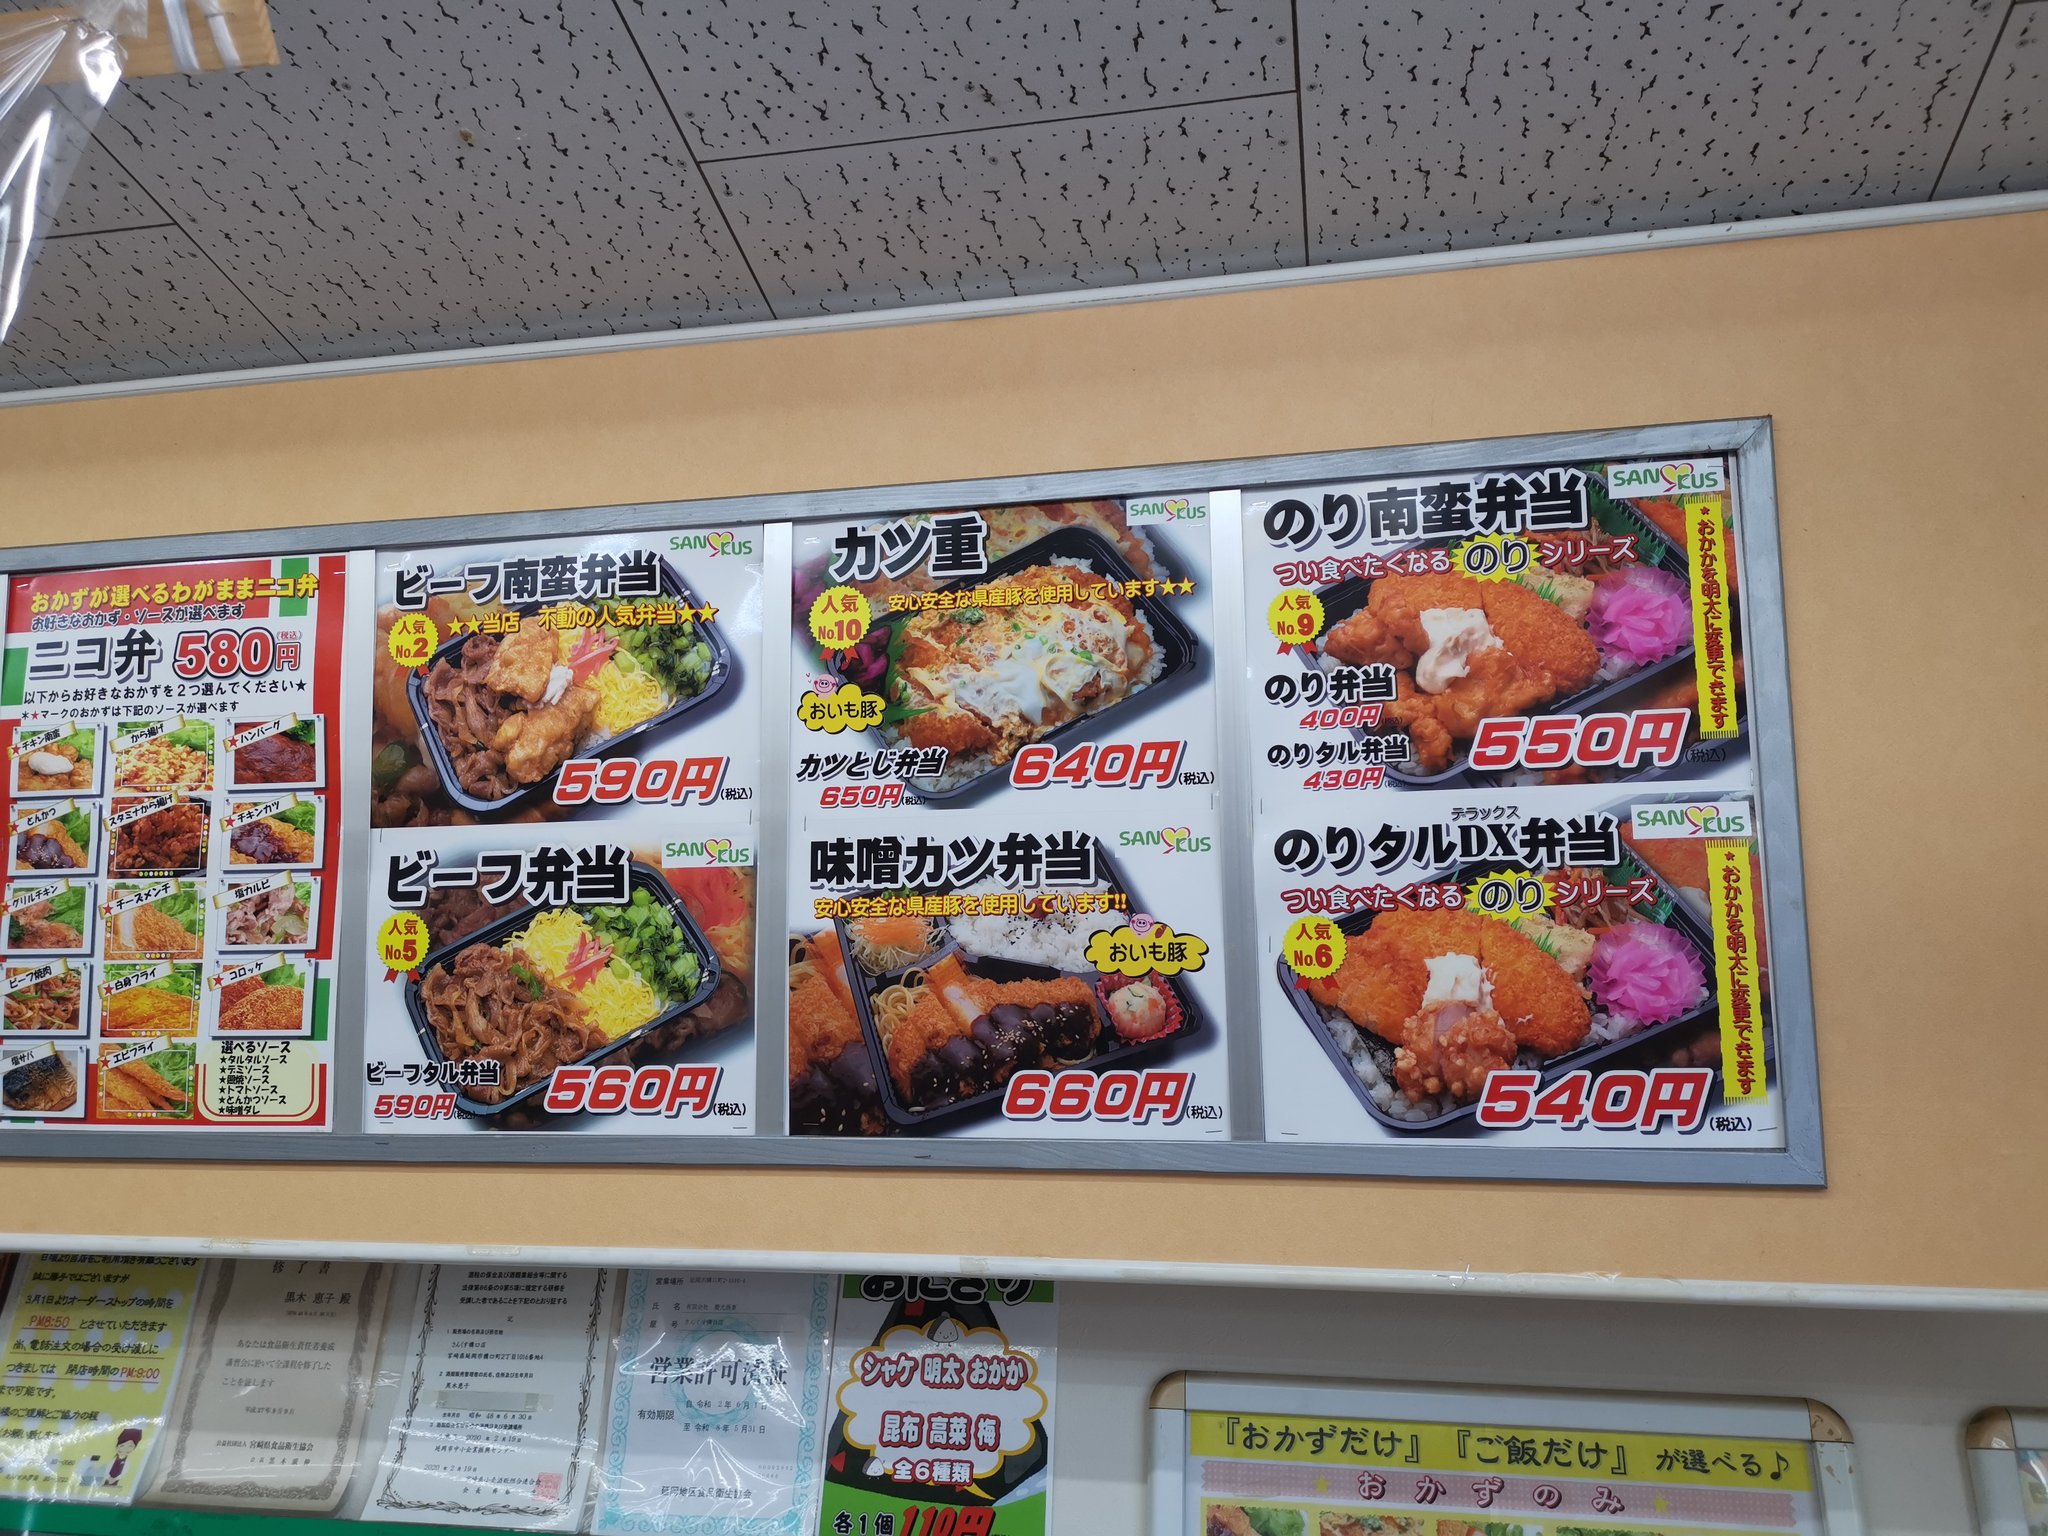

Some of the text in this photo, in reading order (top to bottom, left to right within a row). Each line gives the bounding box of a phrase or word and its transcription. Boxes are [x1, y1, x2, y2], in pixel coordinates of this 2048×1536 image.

[1263, 469, 1590, 548] のり南蛮弁当
[830, 512, 989, 582] カツ重
[1273, 535, 1638, 585] つい食べたくなる のり シリーズ
[394, 549, 664, 609] ビーフ南蛮弁当
[30, 572, 320, 614] おかずが選べるわがままニコ弁
[820, 595, 859, 614] 人気
[888, 578, 1160, 613] 安心安全な県産豚を使用しています
[1279, 594, 1312, 610] 人気
[31, 603, 246, 631] お好きなおかず・ソースが選べます
[398, 619, 426, 636] 人気
[538, 602, 678, 631] 不動の人気弁当
[1277, 613, 1314, 637] No.9
[1696, 518, 1728, 730] おかかを明太に変更できます
[817, 618, 862, 642] No.10
[28, 627, 301, 682] ニコ弁 580円
[395, 637, 429, 660] No.2
[1264, 664, 1396, 706] のり弁当
[809, 699, 878, 720] おいも豚
[1299, 704, 1383, 729] 400円
[21, 727, 61, 751] チキン南蛮
[130, 723, 165, 744] から揚げ
[239, 720, 281, 745] ハンバーグ
[1469, 708, 1727, 771] 550円 (税込)
[797, 748, 947, 780] カツとじ弁当
[1267, 735, 1411, 768] のりタル弁当
[1010, 740, 1215, 789] 640円 (税込)
[553, 756, 753, 806] 590円 (税込)
[1303, 767, 1385, 791] 430円
[819, 784, 904, 808] 650円
[26, 807, 57, 827] とんかつ
[108, 794, 173, 827] スタミナから揚げ
[236, 800, 281, 823] チキンカツ
[1274, 815, 1619, 870] のりタルDX弁当
[810, 831, 1099, 888] 味噌カツ弁当
[233, 878, 271, 899] 塩カルビ
[386, 845, 633, 907] ビーフ弁当
[11, 884, 58, 909] グリルチキン
[115, 882, 171, 910] チーズメンチ
[814, 892, 1127, 919] 安心安全な県産豚を使用しています!!
[1280, 877, 1658, 913] つい食べたくなる のり シリーズ
[387, 919, 419, 936] 人気
[1295, 923, 1331, 940] 人気
[384, 938, 418, 962] No.5
[1109, 941, 1188, 962] おいも豚
[1293, 944, 1333, 968] No.6
[8, 966, 53, 989] ビーフ焼肉
[113, 966, 157, 992] 白身フライ
[229, 960, 264, 981] コロッケ
[1720, 864, 1754, 1096] おかかを明太に変更できます
[10, 1050, 35, 1067] 塩サバ
[112, 1041, 155, 1064] エビフライ
[221, 1040, 291, 1055] 選べるソース
[228, 1055, 288, 1064] タルタルソース
[227, 1065, 270, 1075] デミソース
[366, 1061, 501, 1086] ビーフタル弁当
[226, 1095, 287, 1105] とんかつソース
[228, 1085, 279, 1095] トマトソース
[545, 1064, 747, 1116] 560円 (税込)
[1003, 1070, 1223, 1121] 660円 (税込)
[1477, 1068, 1753, 1132] 540円 (税込)
[373, 1094, 458, 1120] 590円
[79, 1319, 168, 1333] とさせていただきます
[6, 1361, 57, 1375] つきましては
[861, 1352, 1027, 1390] シャケ 明太 おかか
[638, 1409, 675, 1421] 有効期限
[879, 1410, 1000, 1451] 昆布 高菜 梅
[1225, 1416, 1419, 1463] 『おかずだけ』
[1457, 1429, 1627, 1475] 『ご飯だけ』
[892, 1458, 974, 1486] 全6種類
